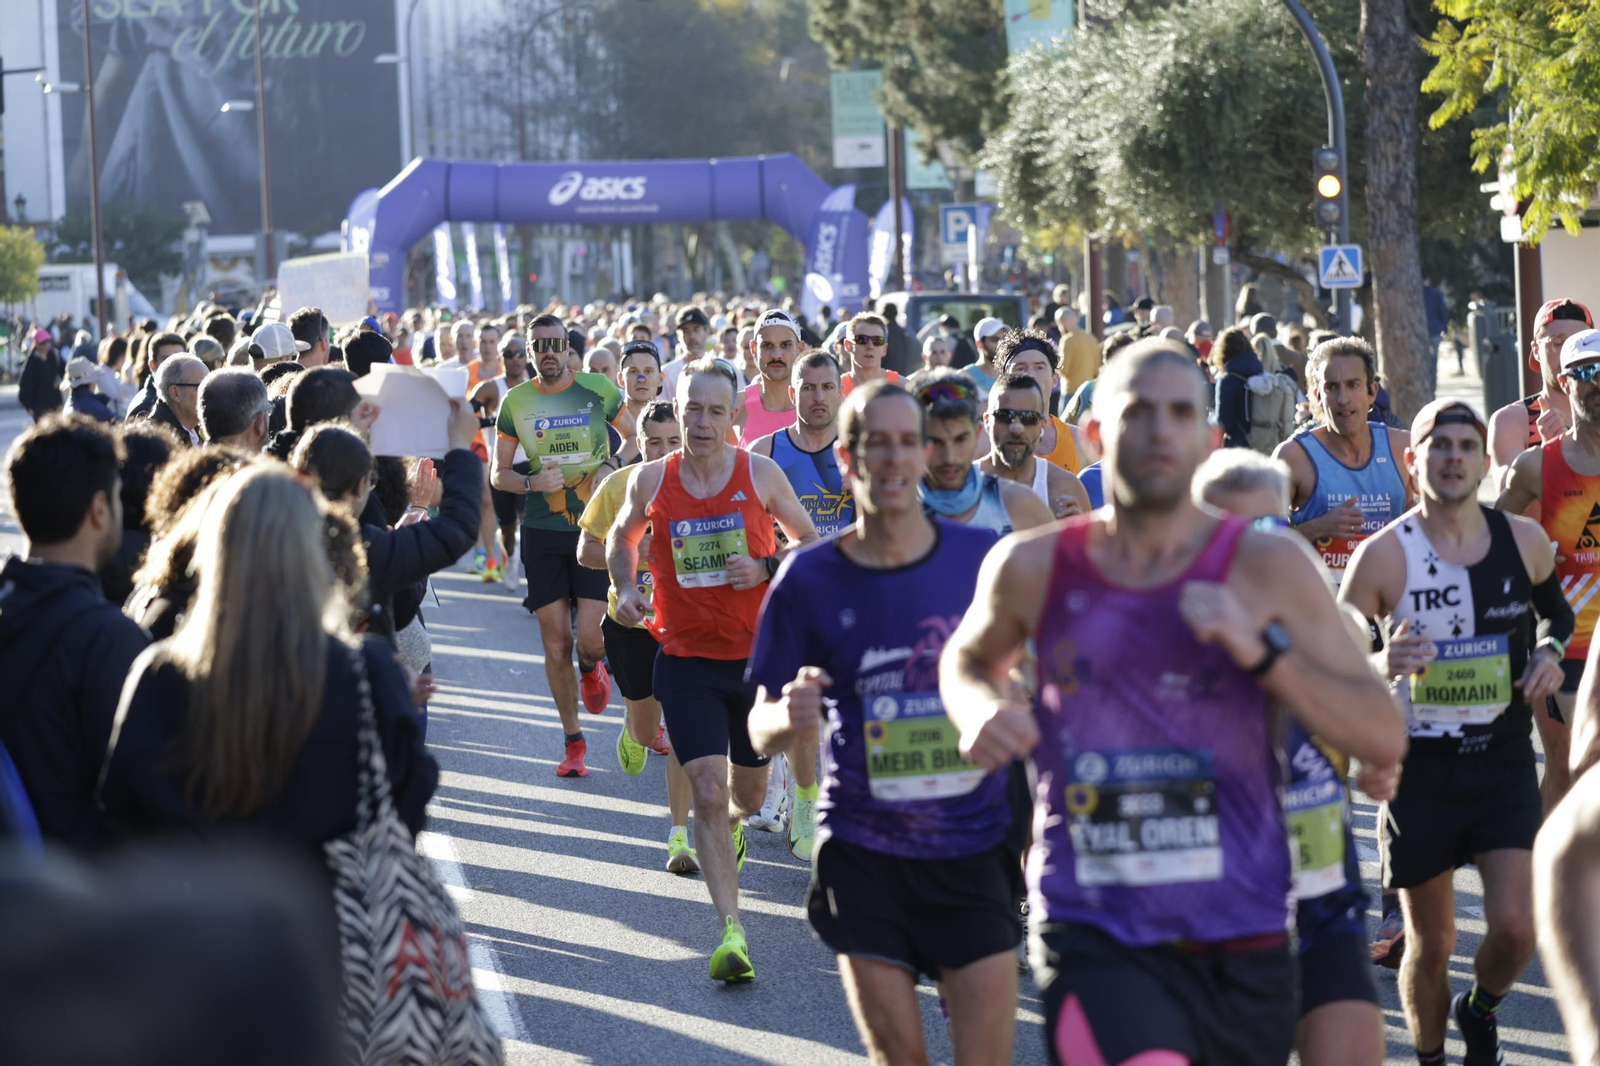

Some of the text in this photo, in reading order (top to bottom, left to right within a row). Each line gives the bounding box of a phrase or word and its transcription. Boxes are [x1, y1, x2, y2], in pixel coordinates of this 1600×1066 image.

[199, 13, 367, 78] futuro
[947, 210, 971, 242] P
[552, 417, 583, 427] ZURICH
[554, 432, 571, 441] 2555
[549, 442, 579, 454] AIDEN
[1327, 493, 1391, 502] MEMRIAL
[695, 518, 735, 532] ZURICH
[815, 525, 839, 534] RICH
[1360, 521, 1385, 531] RICH
[698, 541, 721, 552] 2274
[683, 551, 739, 571] SEAMU
[1321, 552, 1350, 567] CUR
[1573, 552, 1600, 563] TRIJU
[1409, 585, 1461, 612] TRC
[1443, 639, 1498, 657] ZURICH
[1425, 684, 1498, 702] ROMAIN
[871, 752, 925, 773] MEIR
